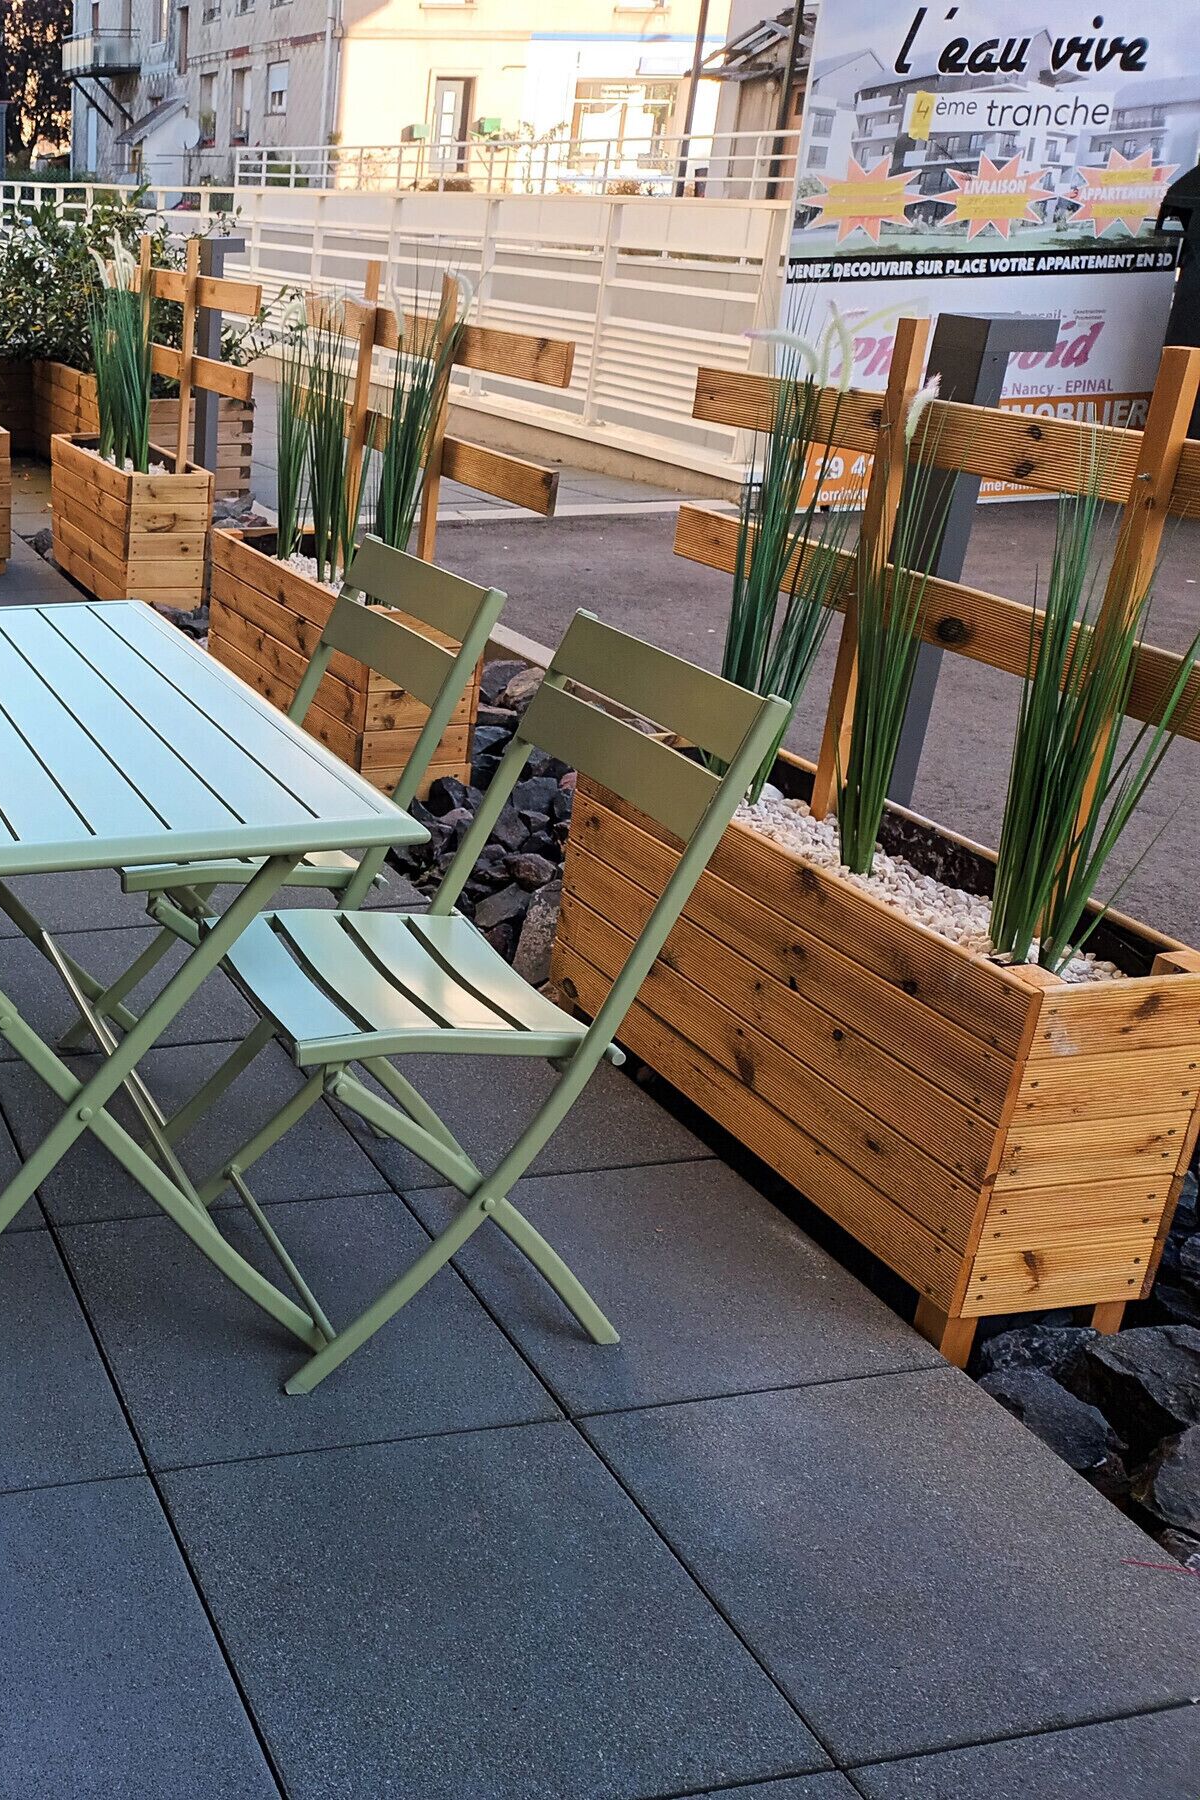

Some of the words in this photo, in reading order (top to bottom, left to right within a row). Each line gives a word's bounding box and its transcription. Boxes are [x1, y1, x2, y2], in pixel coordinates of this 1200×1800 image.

[894, 7, 1032, 74] l'eau
[1051, 15, 1149, 73] vive
[986, 95, 1110, 127] tranche
[963, 179, 1028, 195] LIVRAISON
[787, 263, 832, 280] VENEZ
[832, 260, 913, 278] DECOUVRIR
[915, 259, 943, 275] SUR
[945, 257, 988, 275] PLACE
[989, 256, 1036, 274] VOTRE
[1036, 253, 1135, 271] APPARTEMENT
[1136, 252, 1154, 268] EN
[1156, 252, 1174, 267] 3D
[1011, 382, 1055, 400] Nancy
[1065, 378, 1114, 394] EPINAL
